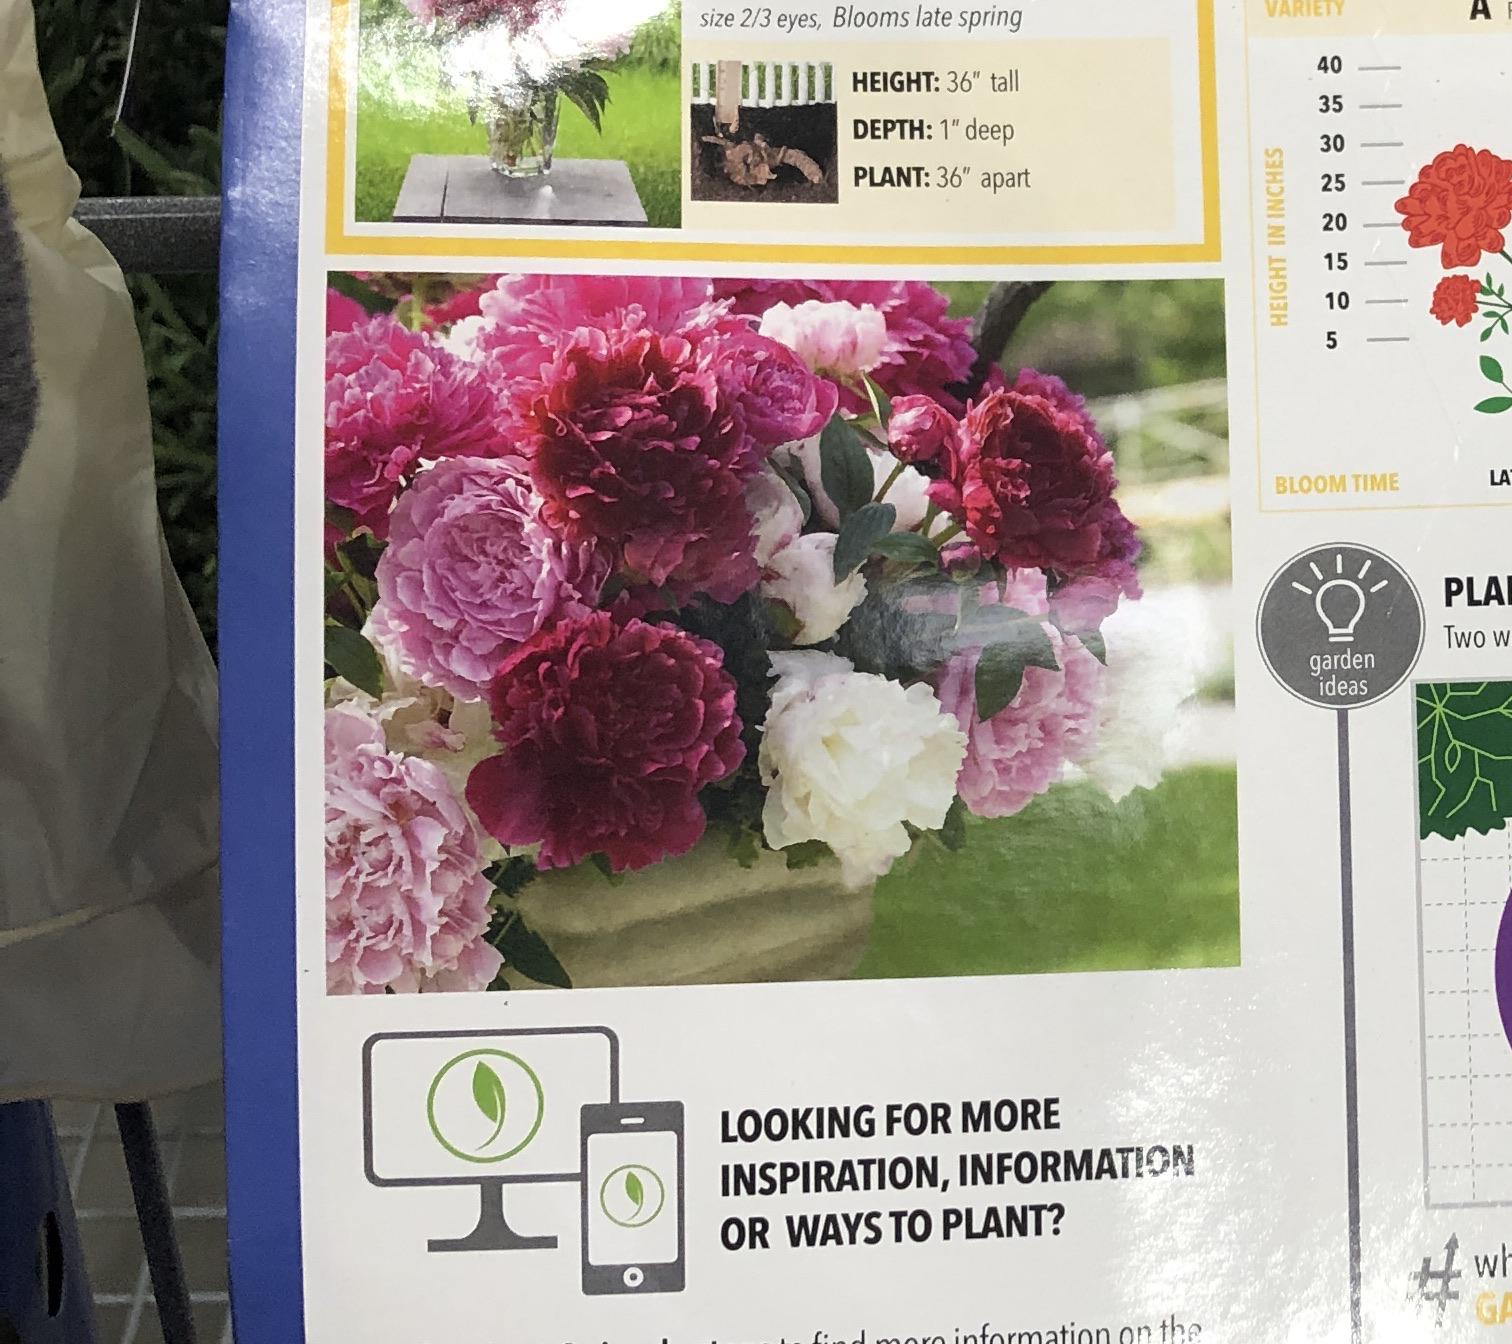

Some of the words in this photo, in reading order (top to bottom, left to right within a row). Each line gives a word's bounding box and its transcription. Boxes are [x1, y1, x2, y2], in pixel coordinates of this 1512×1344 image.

[700, 8, 735, 28] size
[740, 7, 772, 28] 2/3
[777, 13, 822, 34] eyes,
[833, 4, 910, 28] Blooms
[916, 4, 953, 28] late
[958, 4, 1023, 34] spring
[1317, 55, 1342, 74] 40
[852, 70, 940, 93] HEIGHT:
[946, 70, 980, 93] 36"
[990, 68, 1019, 93] tall
[1318, 94, 1344, 114] 35
[853, 118, 933, 140] DEPTH:
[940, 118, 960, 140] 1"
[965, 117, 1014, 147] deep
[1320, 134, 1345, 153] 30
[854, 166, 930, 188] PLANT:
[936, 166, 971, 188] 36"
[980, 168, 1031, 195] apart
[1263, 147, 1285, 218] INCHES
[1321, 173, 1346, 192] 25
[1322, 212, 1348, 232] 20
[1267, 224, 1286, 246] IN
[1324, 252, 1348, 271] 15
[1268, 255, 1289, 327] HEIGHT
[1325, 291, 1350, 310] 10
[1326, 330, 1338, 350] 5
[1275, 474, 1347, 495] BLOOM
[1352, 472, 1400, 492] TIME
[1443, 624, 1486, 649] Two
[1309, 647, 1375, 677] garden
[1319, 674, 1368, 696] ideas
[721, 1104, 876, 1144] LOOKING
[886, 1102, 952, 1136] FOR
[962, 1097, 1060, 1134] MORE
[721, 1155, 950, 1197] INSPIRATION,
[959, 1144, 1195, 1187] INFORMATION
[720, 1216, 770, 1251] OR
[785, 1210, 882, 1248] WAYS
[888, 1208, 932, 1243] TO
[942, 1202, 1066, 1241] PLANT?
